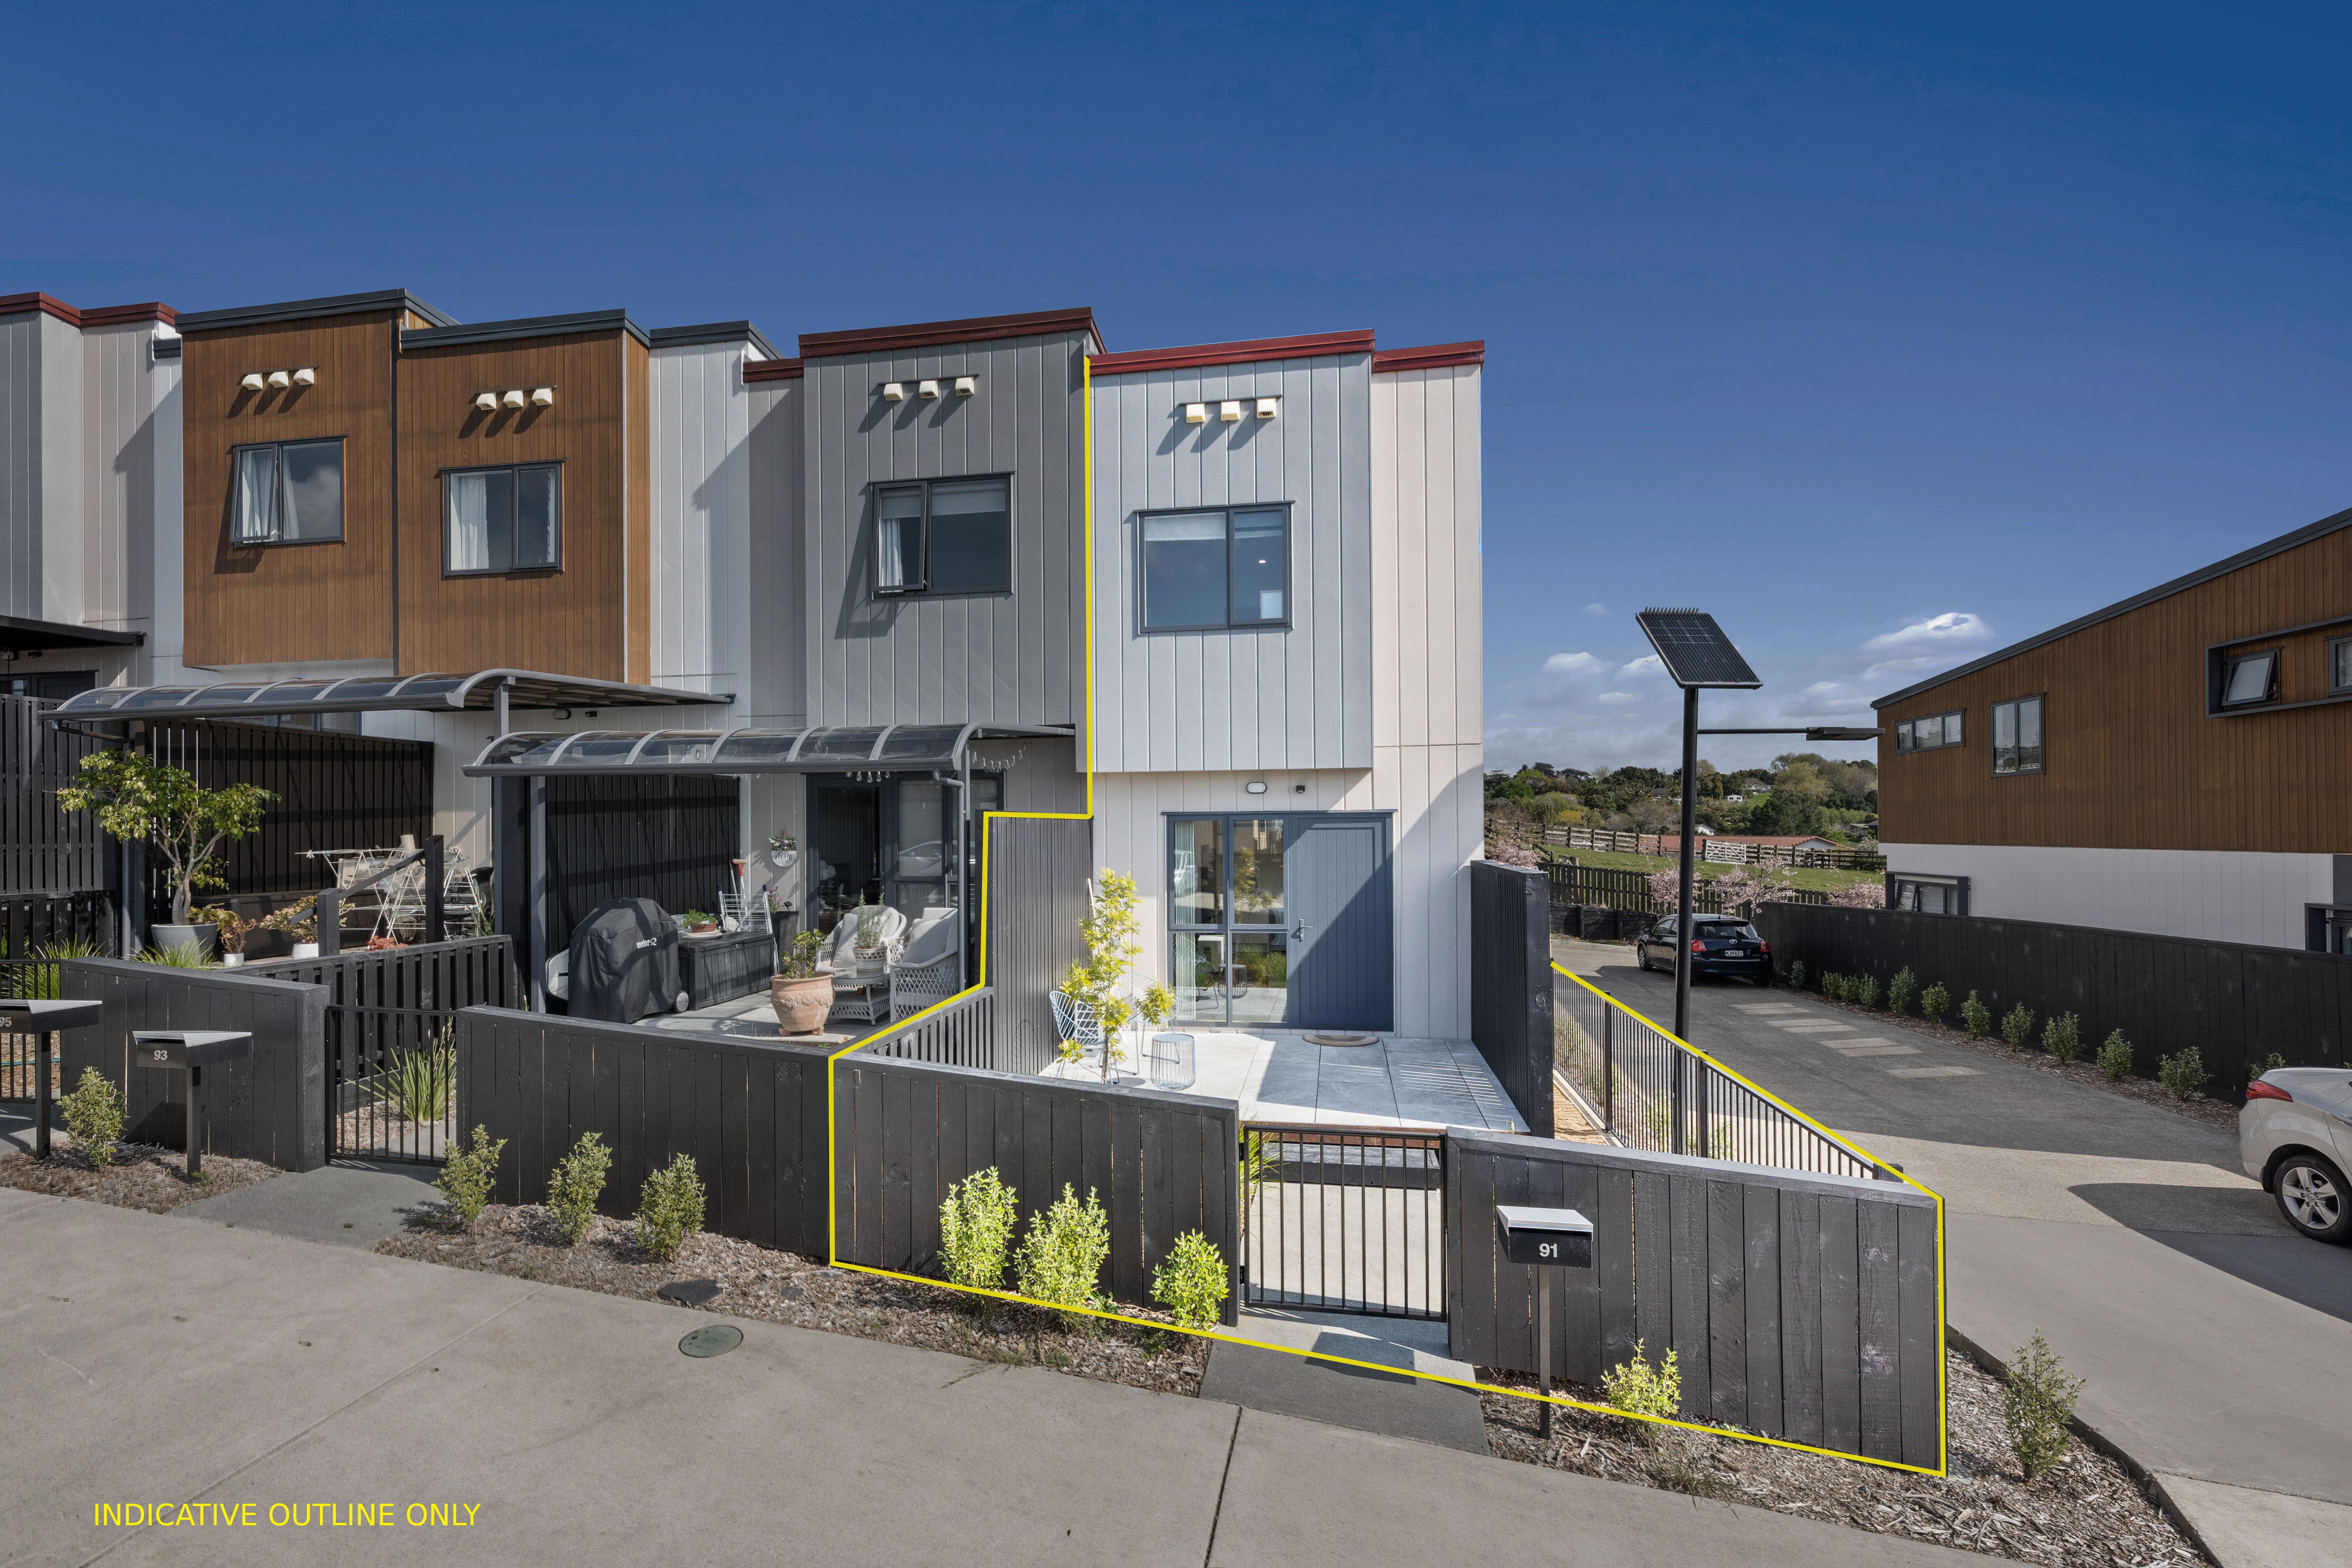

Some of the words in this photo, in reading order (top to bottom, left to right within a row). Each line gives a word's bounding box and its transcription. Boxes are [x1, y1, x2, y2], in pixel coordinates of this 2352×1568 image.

[0, 1017, 12, 1027] 95
[154, 1050, 168, 1060] 93
[1539, 1243, 1557, 1258] 91
